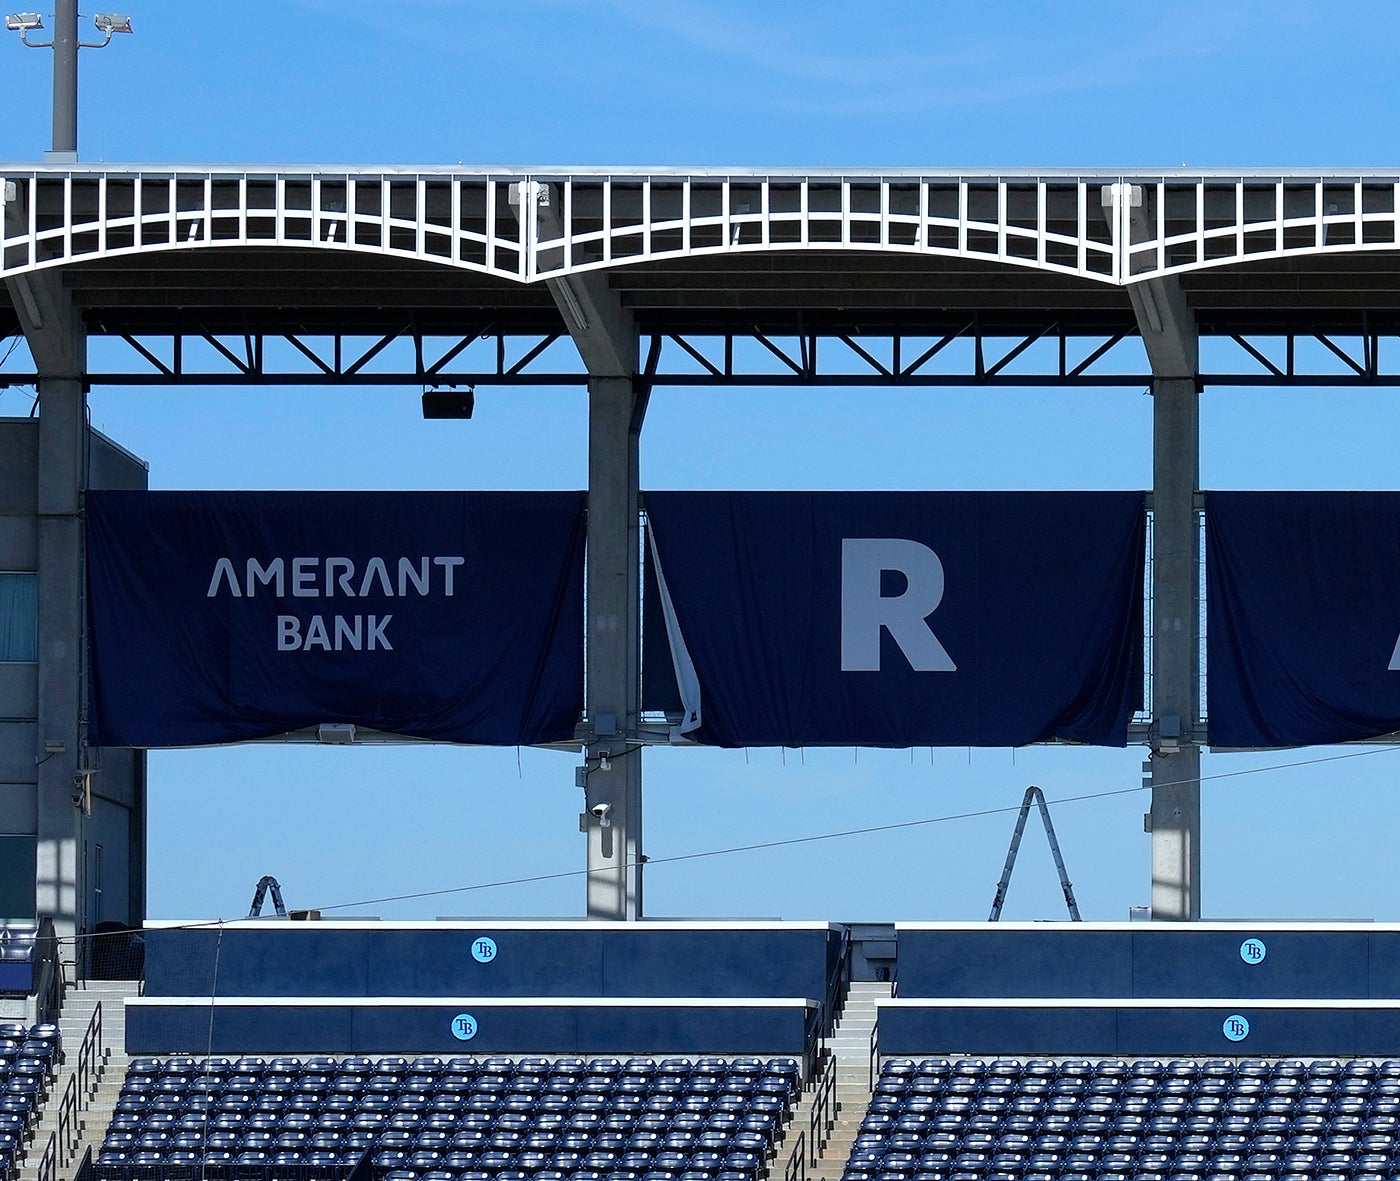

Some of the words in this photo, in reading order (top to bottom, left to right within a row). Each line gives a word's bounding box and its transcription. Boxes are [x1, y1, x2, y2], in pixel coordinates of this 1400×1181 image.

[207, 556, 465, 597] AMERANT
[840, 538, 956, 671] R
[277, 614, 393, 651] BANK
